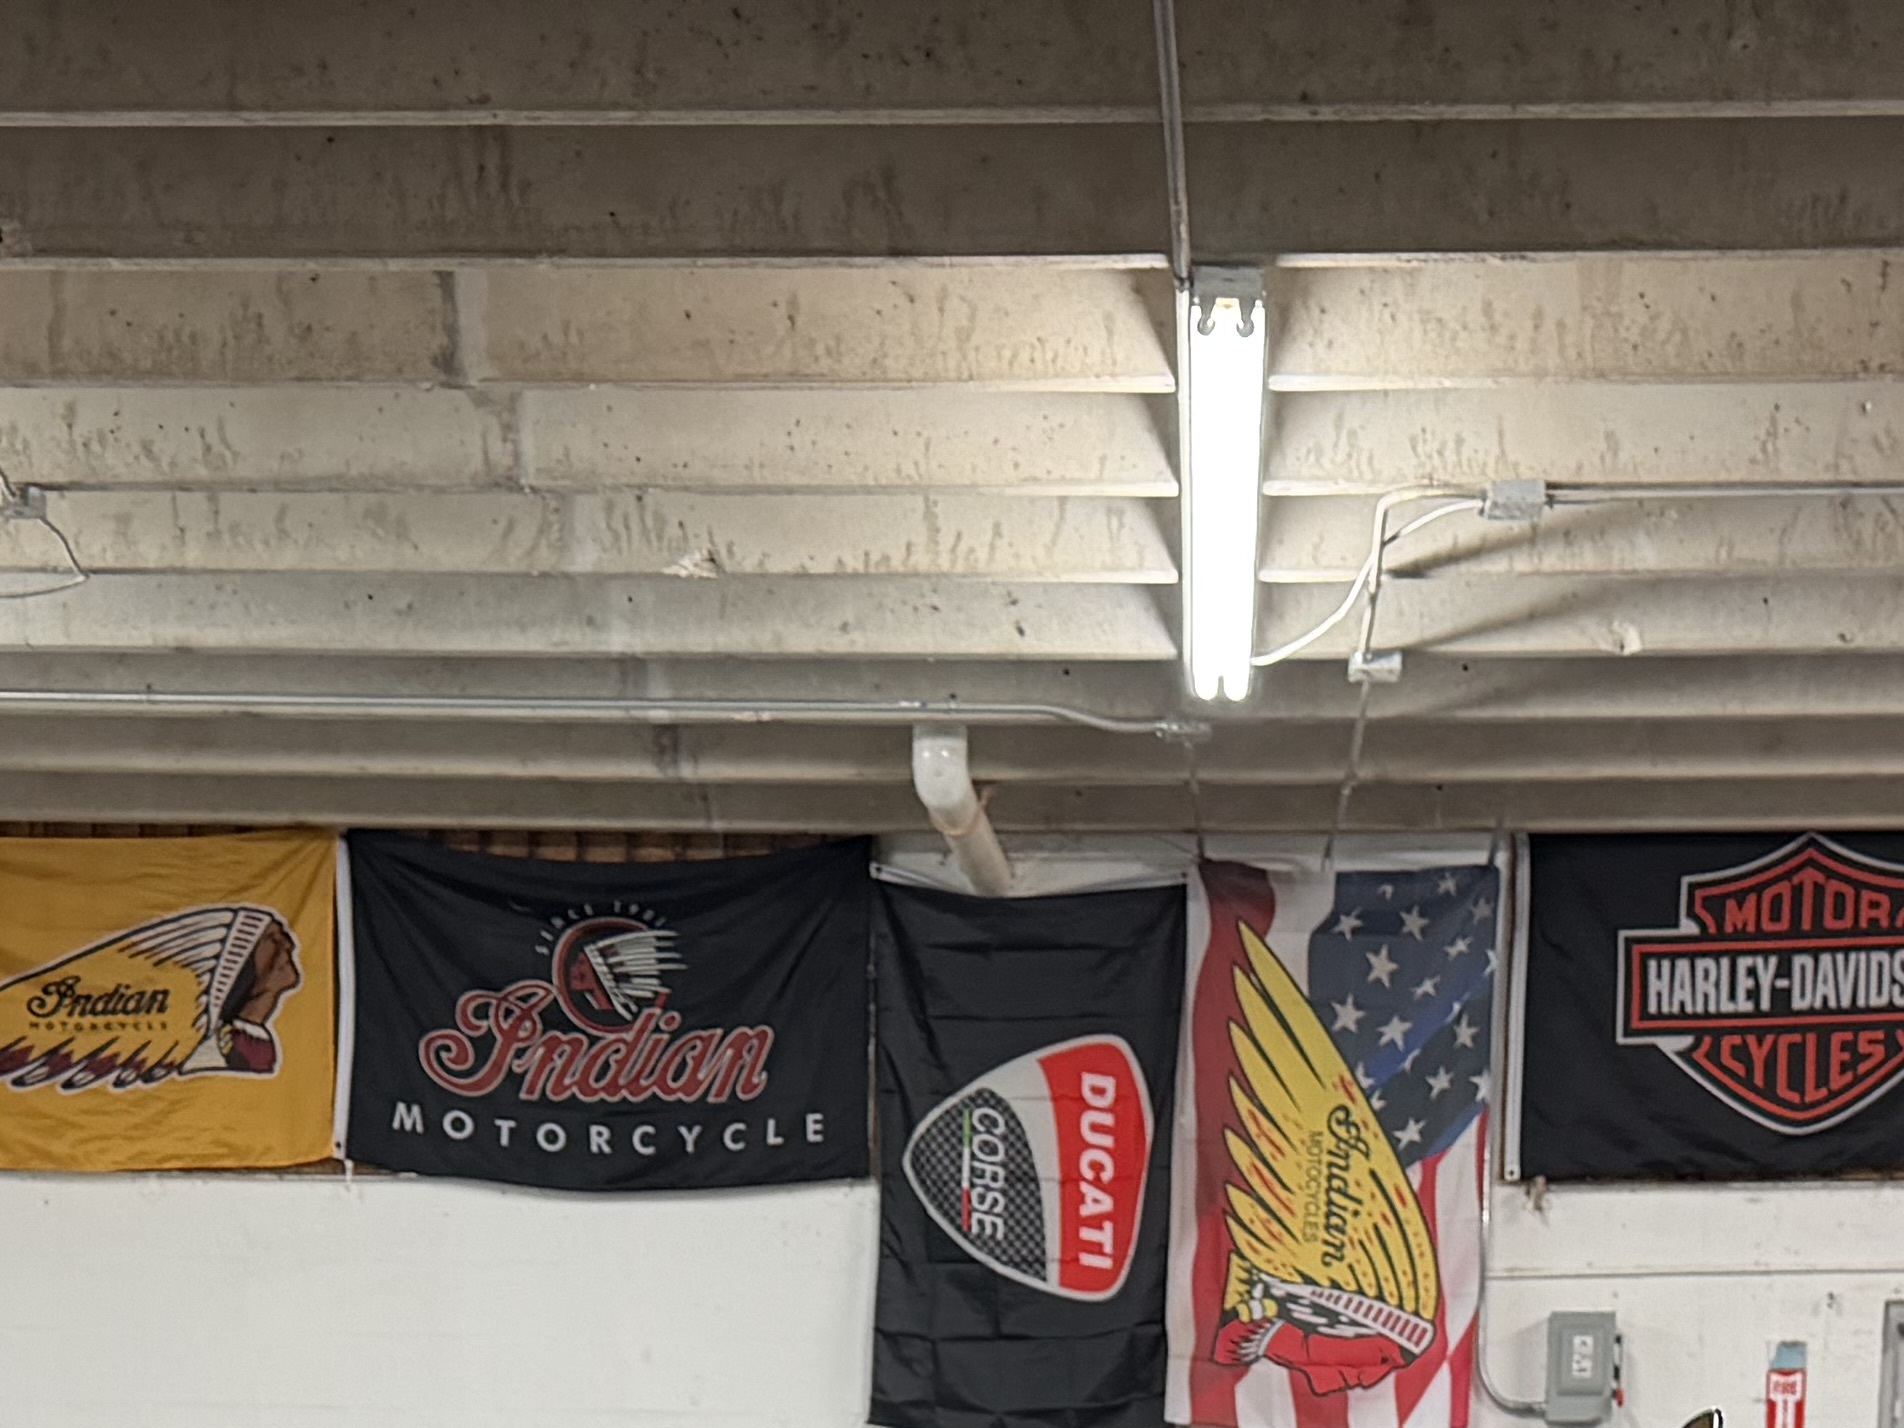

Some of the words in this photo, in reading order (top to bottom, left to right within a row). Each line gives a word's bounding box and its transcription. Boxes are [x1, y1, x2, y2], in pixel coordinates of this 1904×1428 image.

[1723, 864, 1892, 935] MOTOR
[27, 975, 170, 1018] Indian
[418, 979, 774, 1102] Indian
[1719, 1029, 1886, 1104] CYCLES
[392, 1101, 825, 1155] MOTORCYCLE
[971, 1107, 1007, 1241] CORSE
[1078, 1071, 1117, 1270] DUCATI
[1321, 1104, 1371, 1268] Indian
